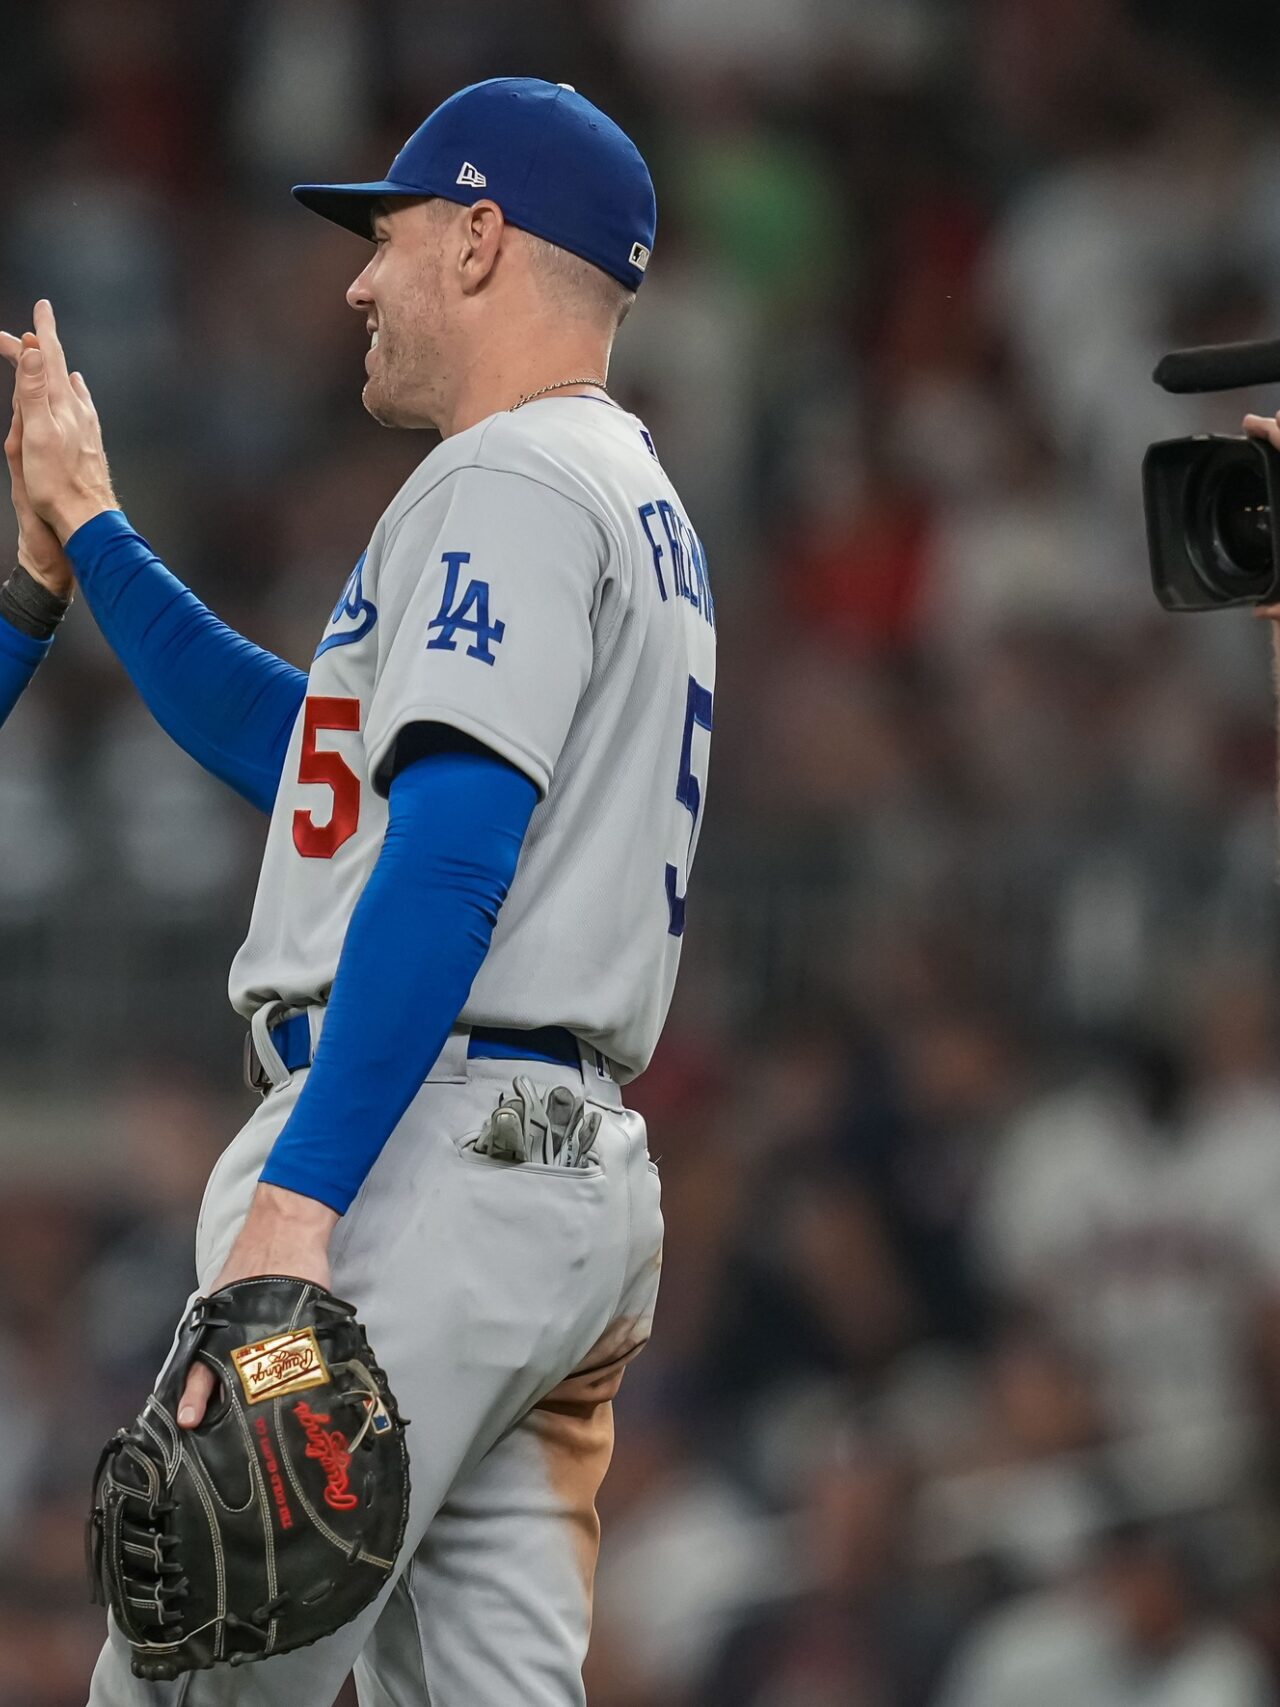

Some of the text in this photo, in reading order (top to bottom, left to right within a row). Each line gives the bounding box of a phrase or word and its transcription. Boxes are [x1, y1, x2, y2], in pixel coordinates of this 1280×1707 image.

[427, 552, 505, 666] LA
[292, 696, 360, 859] 5
[666, 673, 713, 937] 5
[250, 1348, 313, 1384] Rawlings
[294, 1402, 358, 1510] Rawlings
